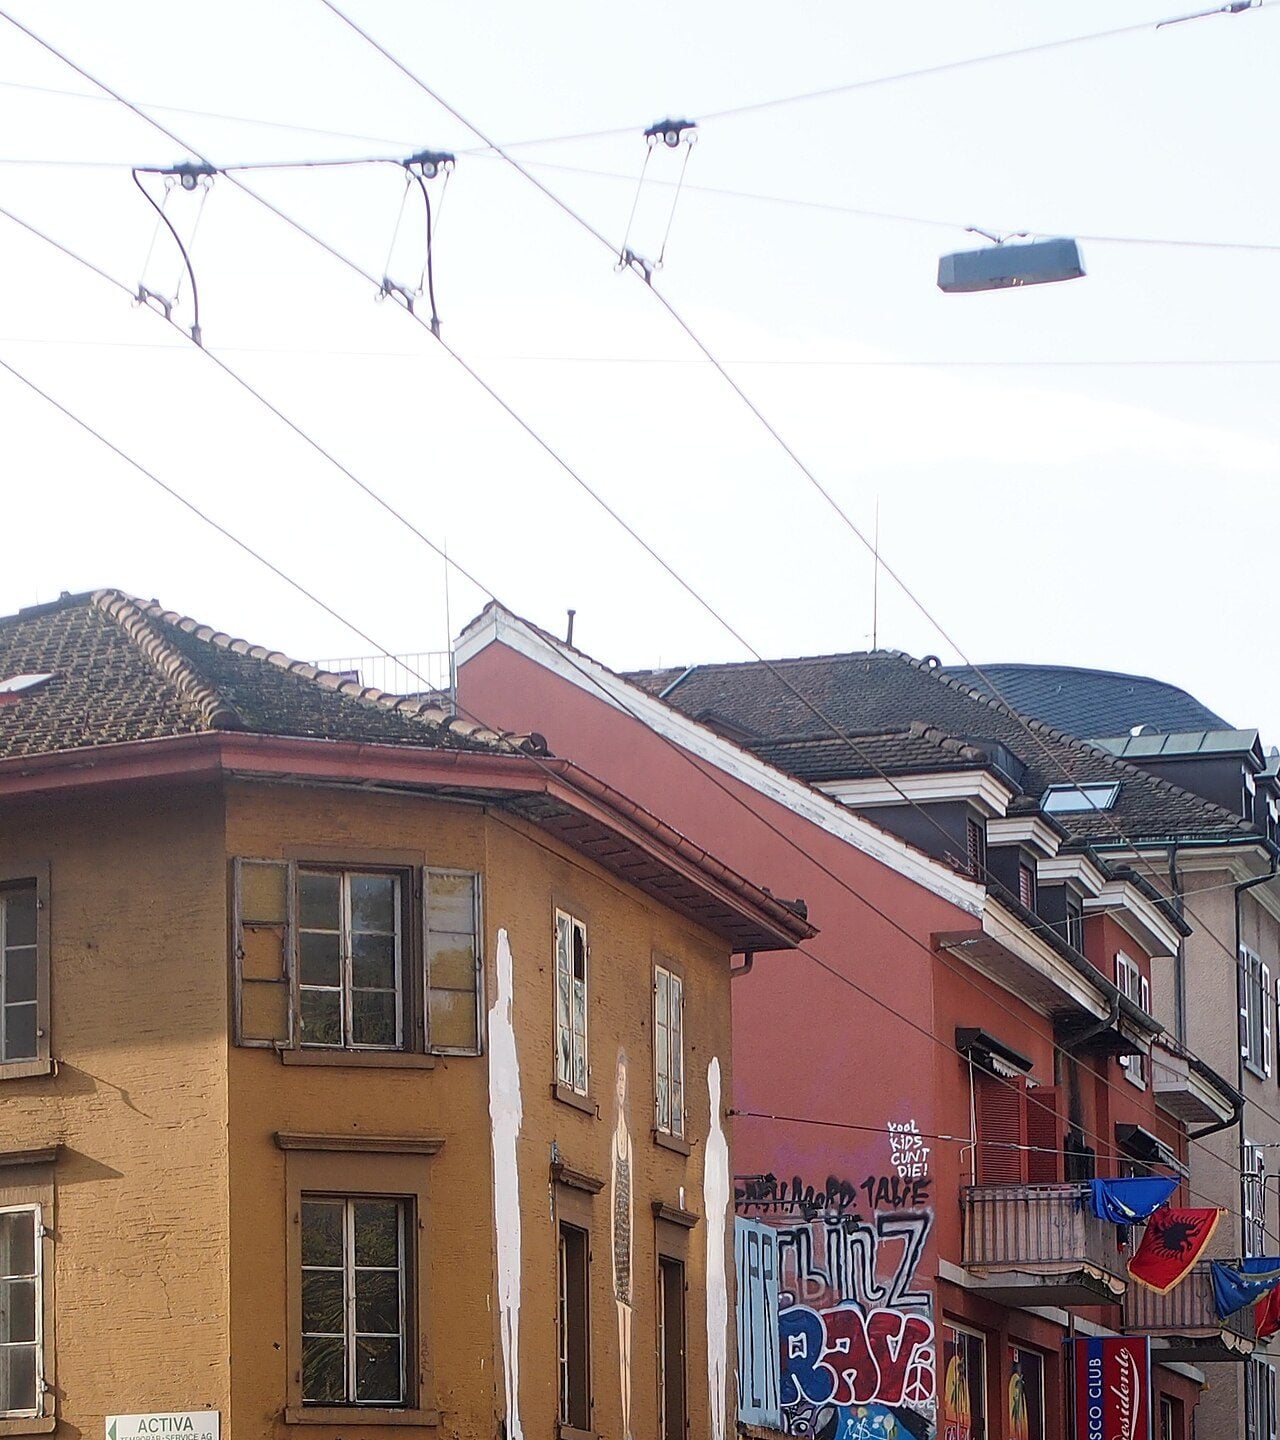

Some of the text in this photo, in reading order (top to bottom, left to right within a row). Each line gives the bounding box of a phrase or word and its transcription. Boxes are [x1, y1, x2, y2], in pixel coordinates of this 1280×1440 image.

[1089, 1358, 1102, 1398] CLUB
[138, 1417, 194, 1433] ACTIVA
[200, 1432, 213, 1440] AG
